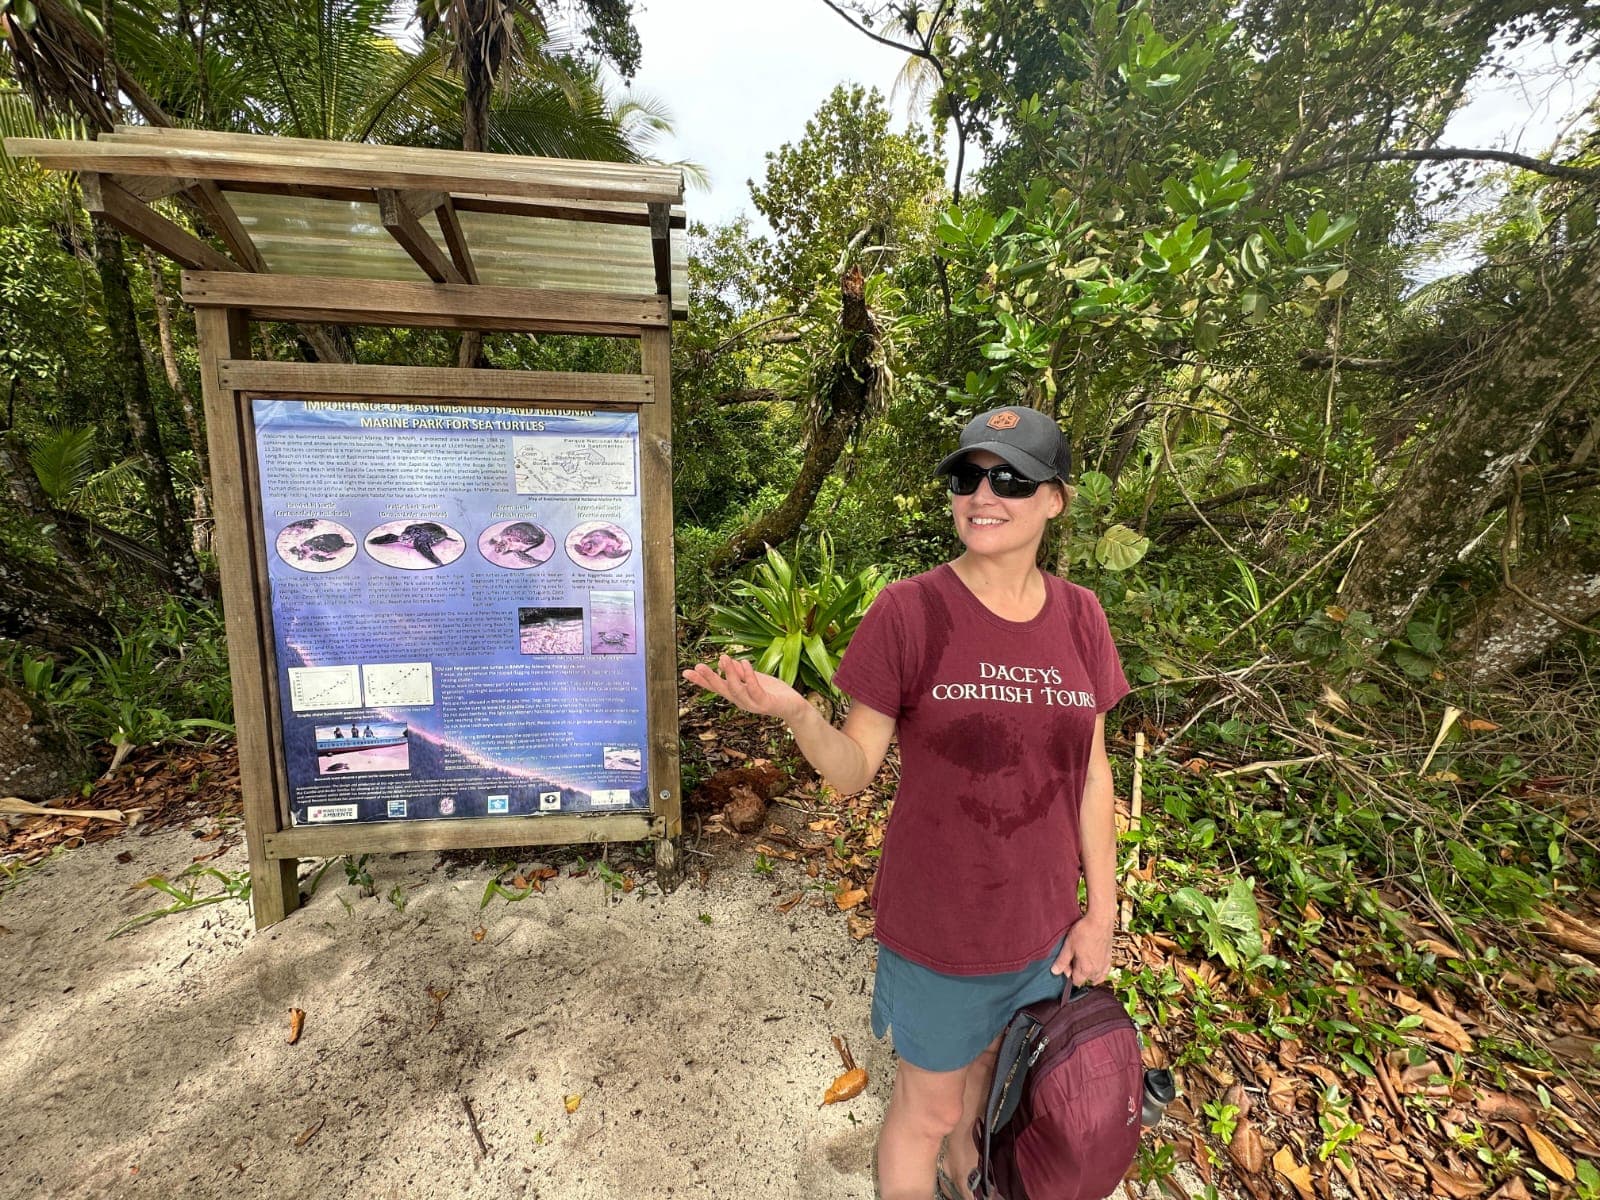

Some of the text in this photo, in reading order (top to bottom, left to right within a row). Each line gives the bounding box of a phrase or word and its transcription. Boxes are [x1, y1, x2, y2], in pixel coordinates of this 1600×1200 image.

[304, 401, 386, 412] IMPORTANCE
[388, 404, 403, 413] OF
[407, 404, 490, 414] BASTIMENTOS
[491, 406, 534, 416] ISLAND
[361, 417, 545, 432] MARINE PARK FOR SEA TURTLES
[979, 662, 1063, 684] DACEY'S
[932, 684, 1097, 708] CORNISH TOURS
